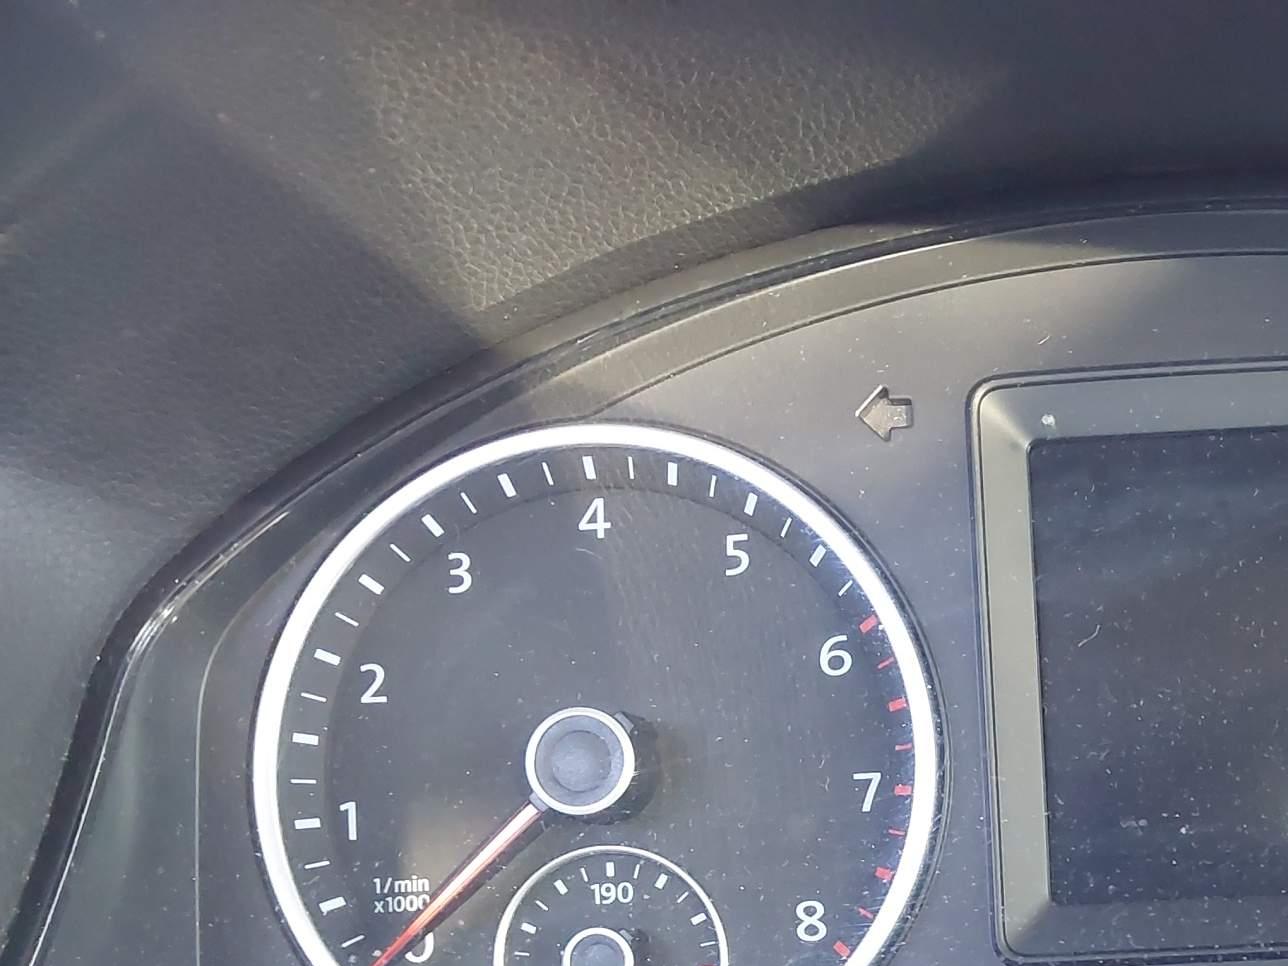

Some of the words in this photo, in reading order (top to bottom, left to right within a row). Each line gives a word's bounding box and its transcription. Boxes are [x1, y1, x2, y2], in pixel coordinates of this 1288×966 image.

[578, 497, 611, 539] 4
[447, 552, 472, 594] 3
[725, 533, 750, 576] 5
[819, 634, 852, 676] 6
[359, 663, 388, 704] 2
[852, 772, 882, 813] 7
[340, 801, 357, 841] 1
[373, 875, 430, 894] 1/min
[590, 882, 634, 905] 190
[795, 900, 827, 942] 8
